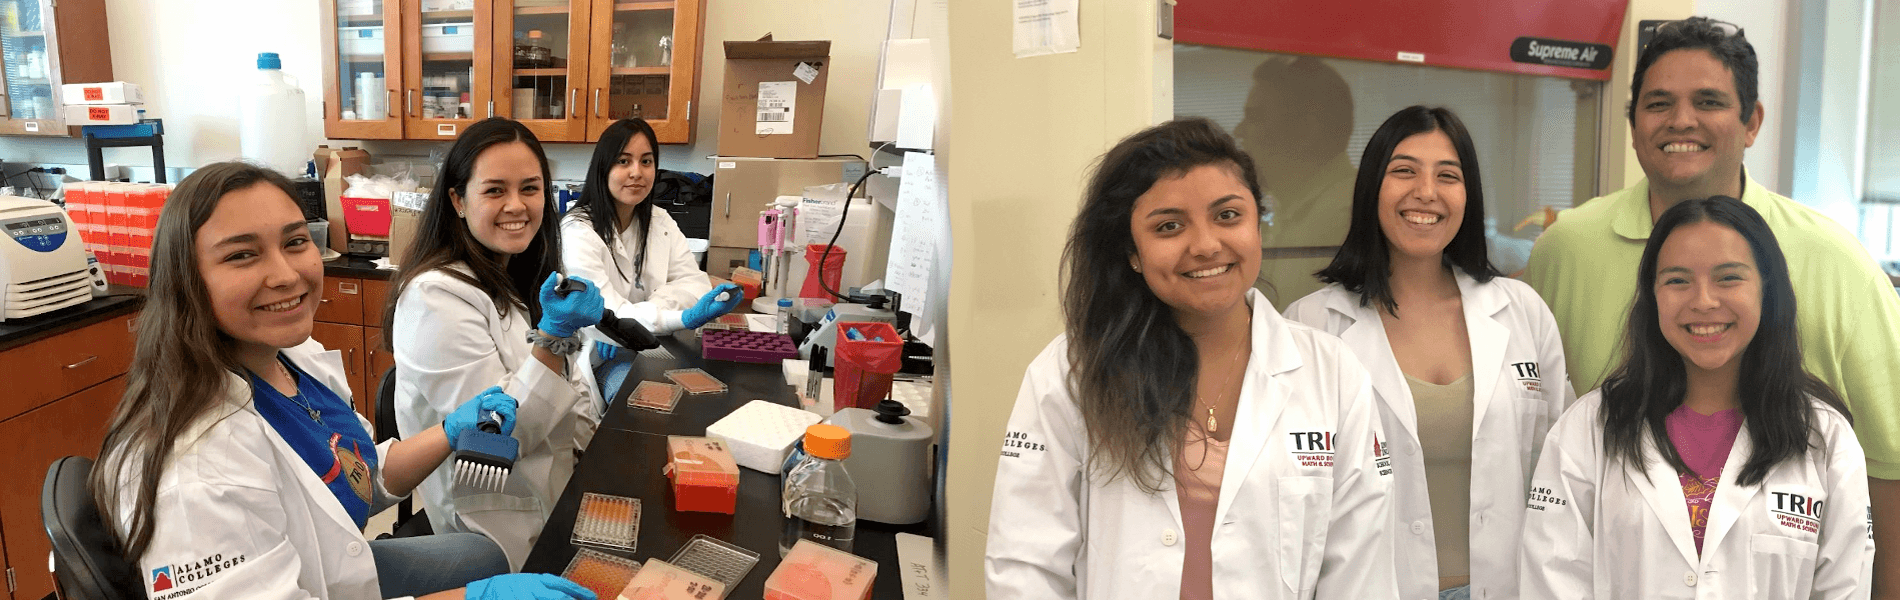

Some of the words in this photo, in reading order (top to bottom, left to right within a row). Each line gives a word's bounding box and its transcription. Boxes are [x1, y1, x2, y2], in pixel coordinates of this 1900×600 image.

[1527, 39, 1580, 60] Supreme
[1579, 46, 1599, 62] Air
[1005, 431, 1028, 440] AMO
[1529, 486, 1552, 495] AMO
[1771, 491, 1823, 519] TRIO
[1776, 513, 1804, 524] UPWARD
[1780, 520, 1797, 528] MATH
[177, 553, 222, 575] ALAMO
[178, 554, 246, 584] COLLEGES
[167, 587, 196, 600] ANTONIO
